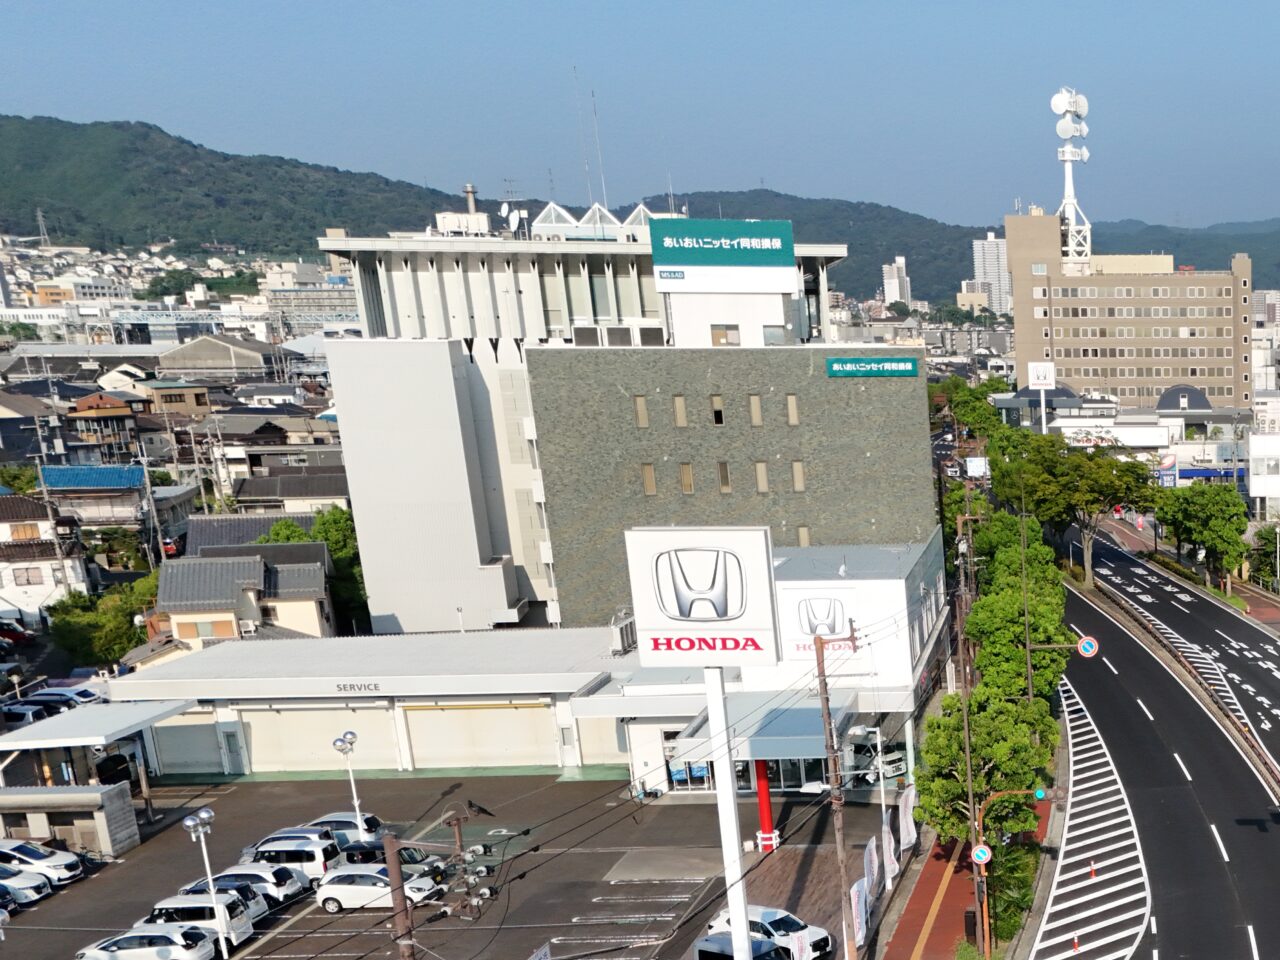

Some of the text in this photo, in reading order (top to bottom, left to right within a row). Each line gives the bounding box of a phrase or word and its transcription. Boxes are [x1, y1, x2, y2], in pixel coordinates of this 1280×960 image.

[663, 236, 782, 250] あいおいニッセイ同和損保
[832, 362, 913, 372] あいおいニッセイ同和損保
[650, 637, 764, 651] HONDA
[336, 683, 381, 692] SERVICE
